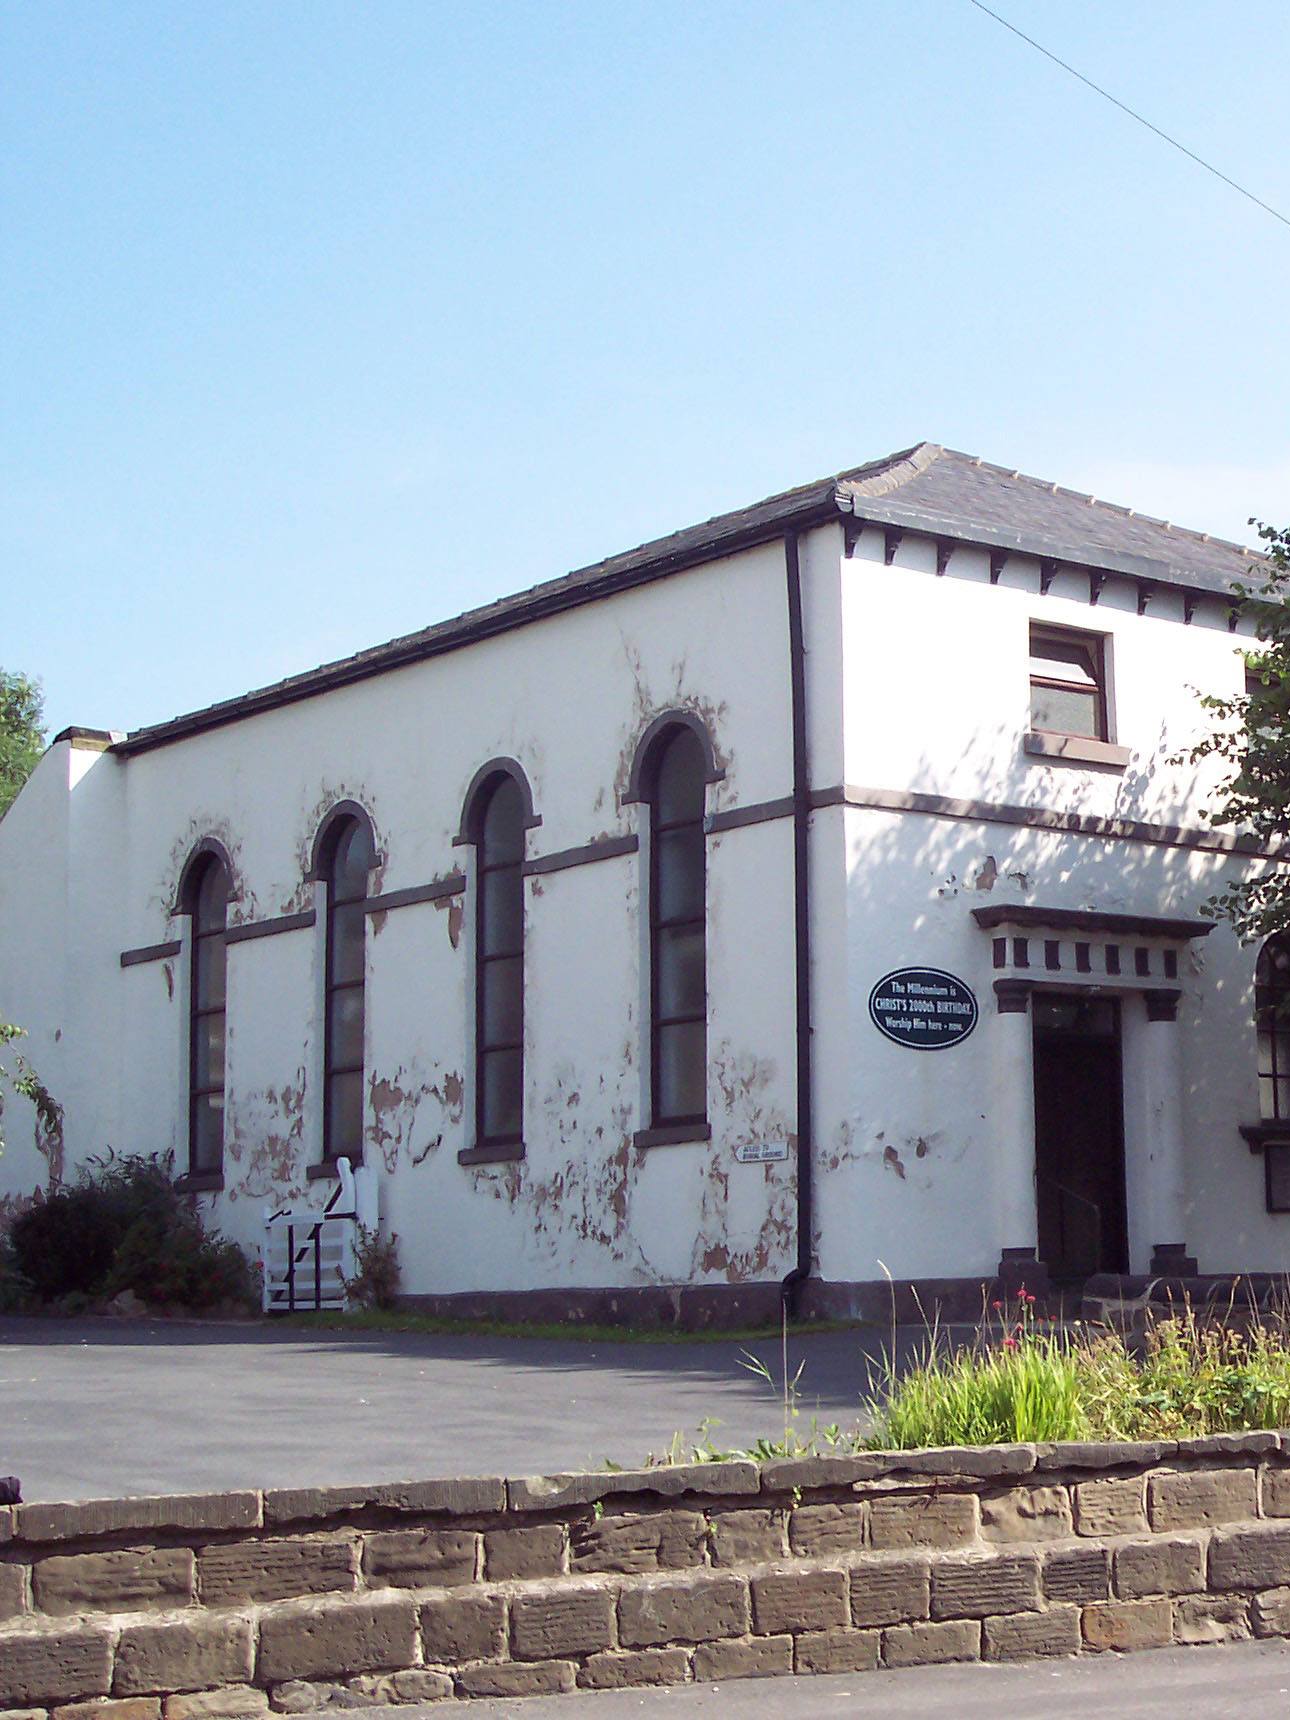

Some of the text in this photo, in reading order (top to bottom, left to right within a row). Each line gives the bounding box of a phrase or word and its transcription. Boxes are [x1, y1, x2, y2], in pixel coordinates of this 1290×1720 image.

[891, 981, 956, 996] The Millennium is
[875, 997, 907, 1012] CHRIST'S
[908, 999, 935, 1012] 2000th
[885, 1016, 912, 1032] Worship
[913, 1018, 926, 1029] Him
[928, 1018, 942, 1030] here
